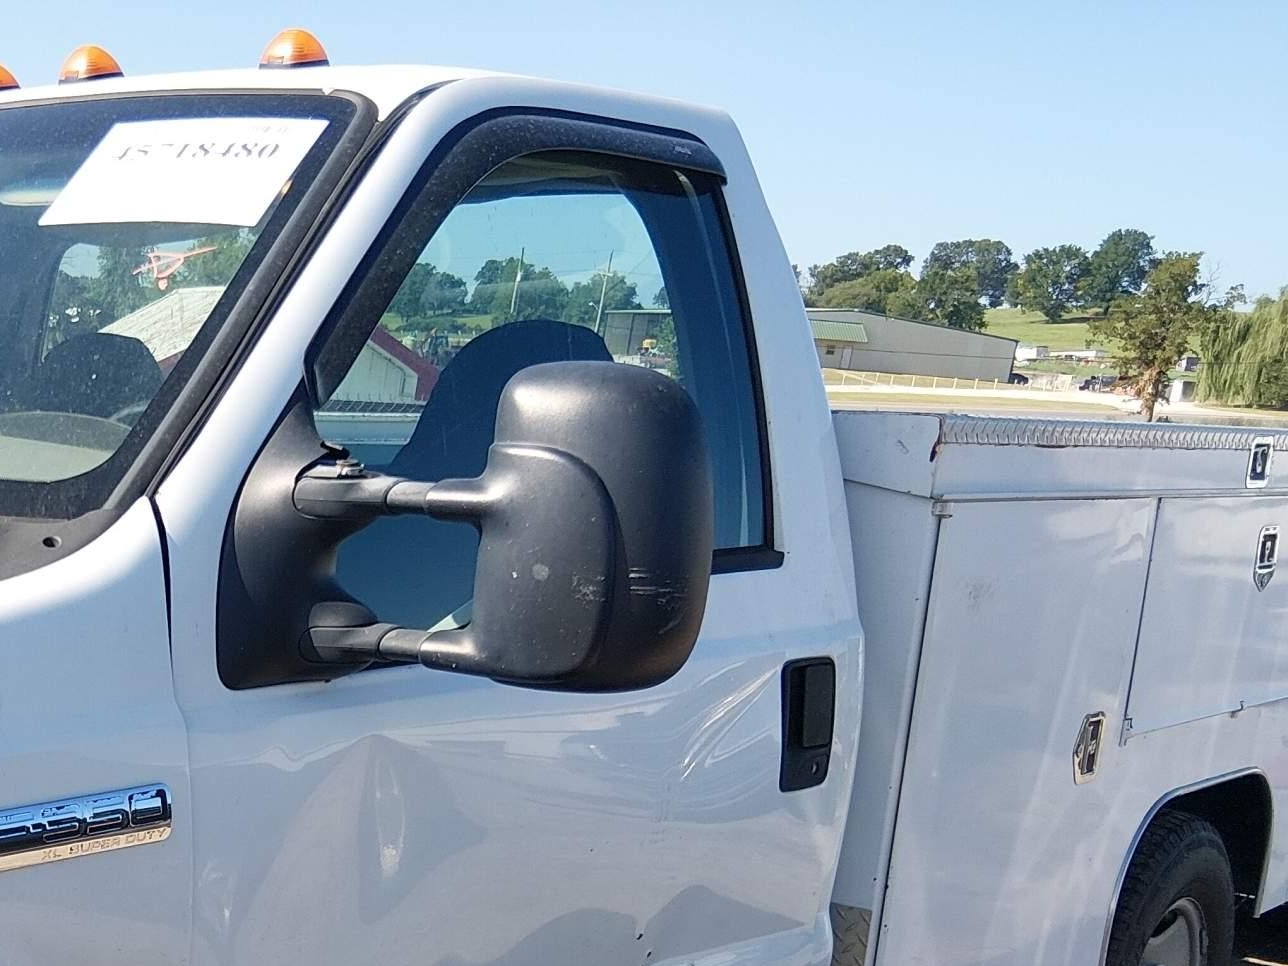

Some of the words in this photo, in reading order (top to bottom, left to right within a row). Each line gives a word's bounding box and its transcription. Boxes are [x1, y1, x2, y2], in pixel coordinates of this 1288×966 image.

[41, 849, 62, 860] XL
[69, 838, 121, 855] SUPER
[126, 828, 166, 845] DUTY
